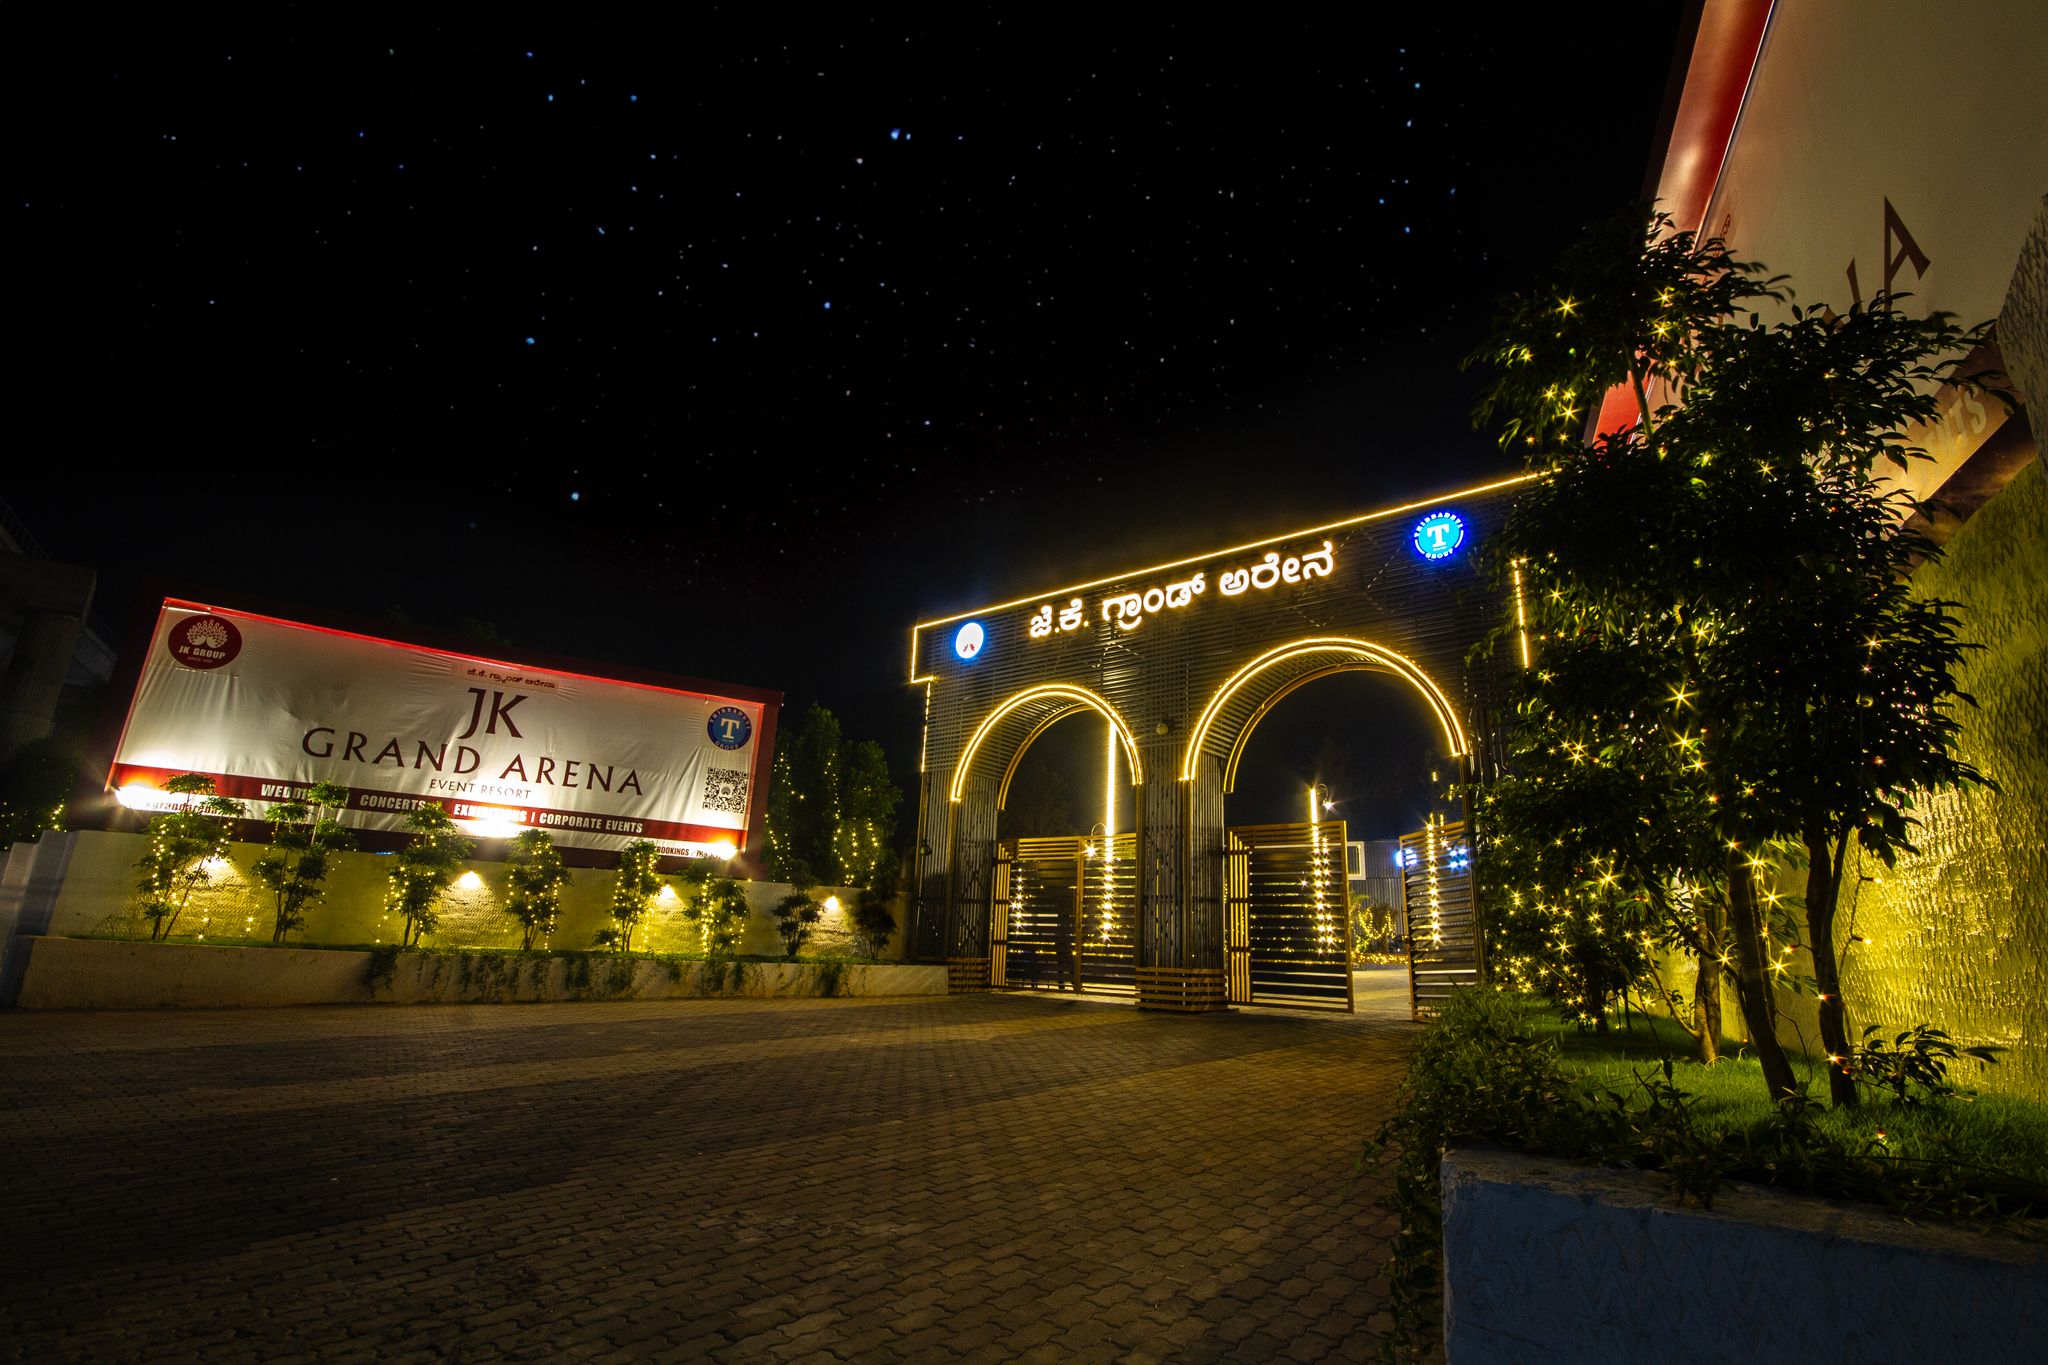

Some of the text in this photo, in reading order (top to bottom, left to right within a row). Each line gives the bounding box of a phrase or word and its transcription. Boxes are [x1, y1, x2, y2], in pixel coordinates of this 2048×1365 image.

[1426, 523, 1450, 548] T
[178, 645, 226, 659] JK GROUP
[457, 687, 529, 739] JK
[721, 718, 740, 739] T
[302, 727, 643, 796] GRAND ARENA
[430, 778, 532, 800] EVENT RESORT
[360, 794, 427, 812] CONCERTS
[539, 812, 602, 830] CORPORATE
[605, 821, 643, 834] EVENTS
